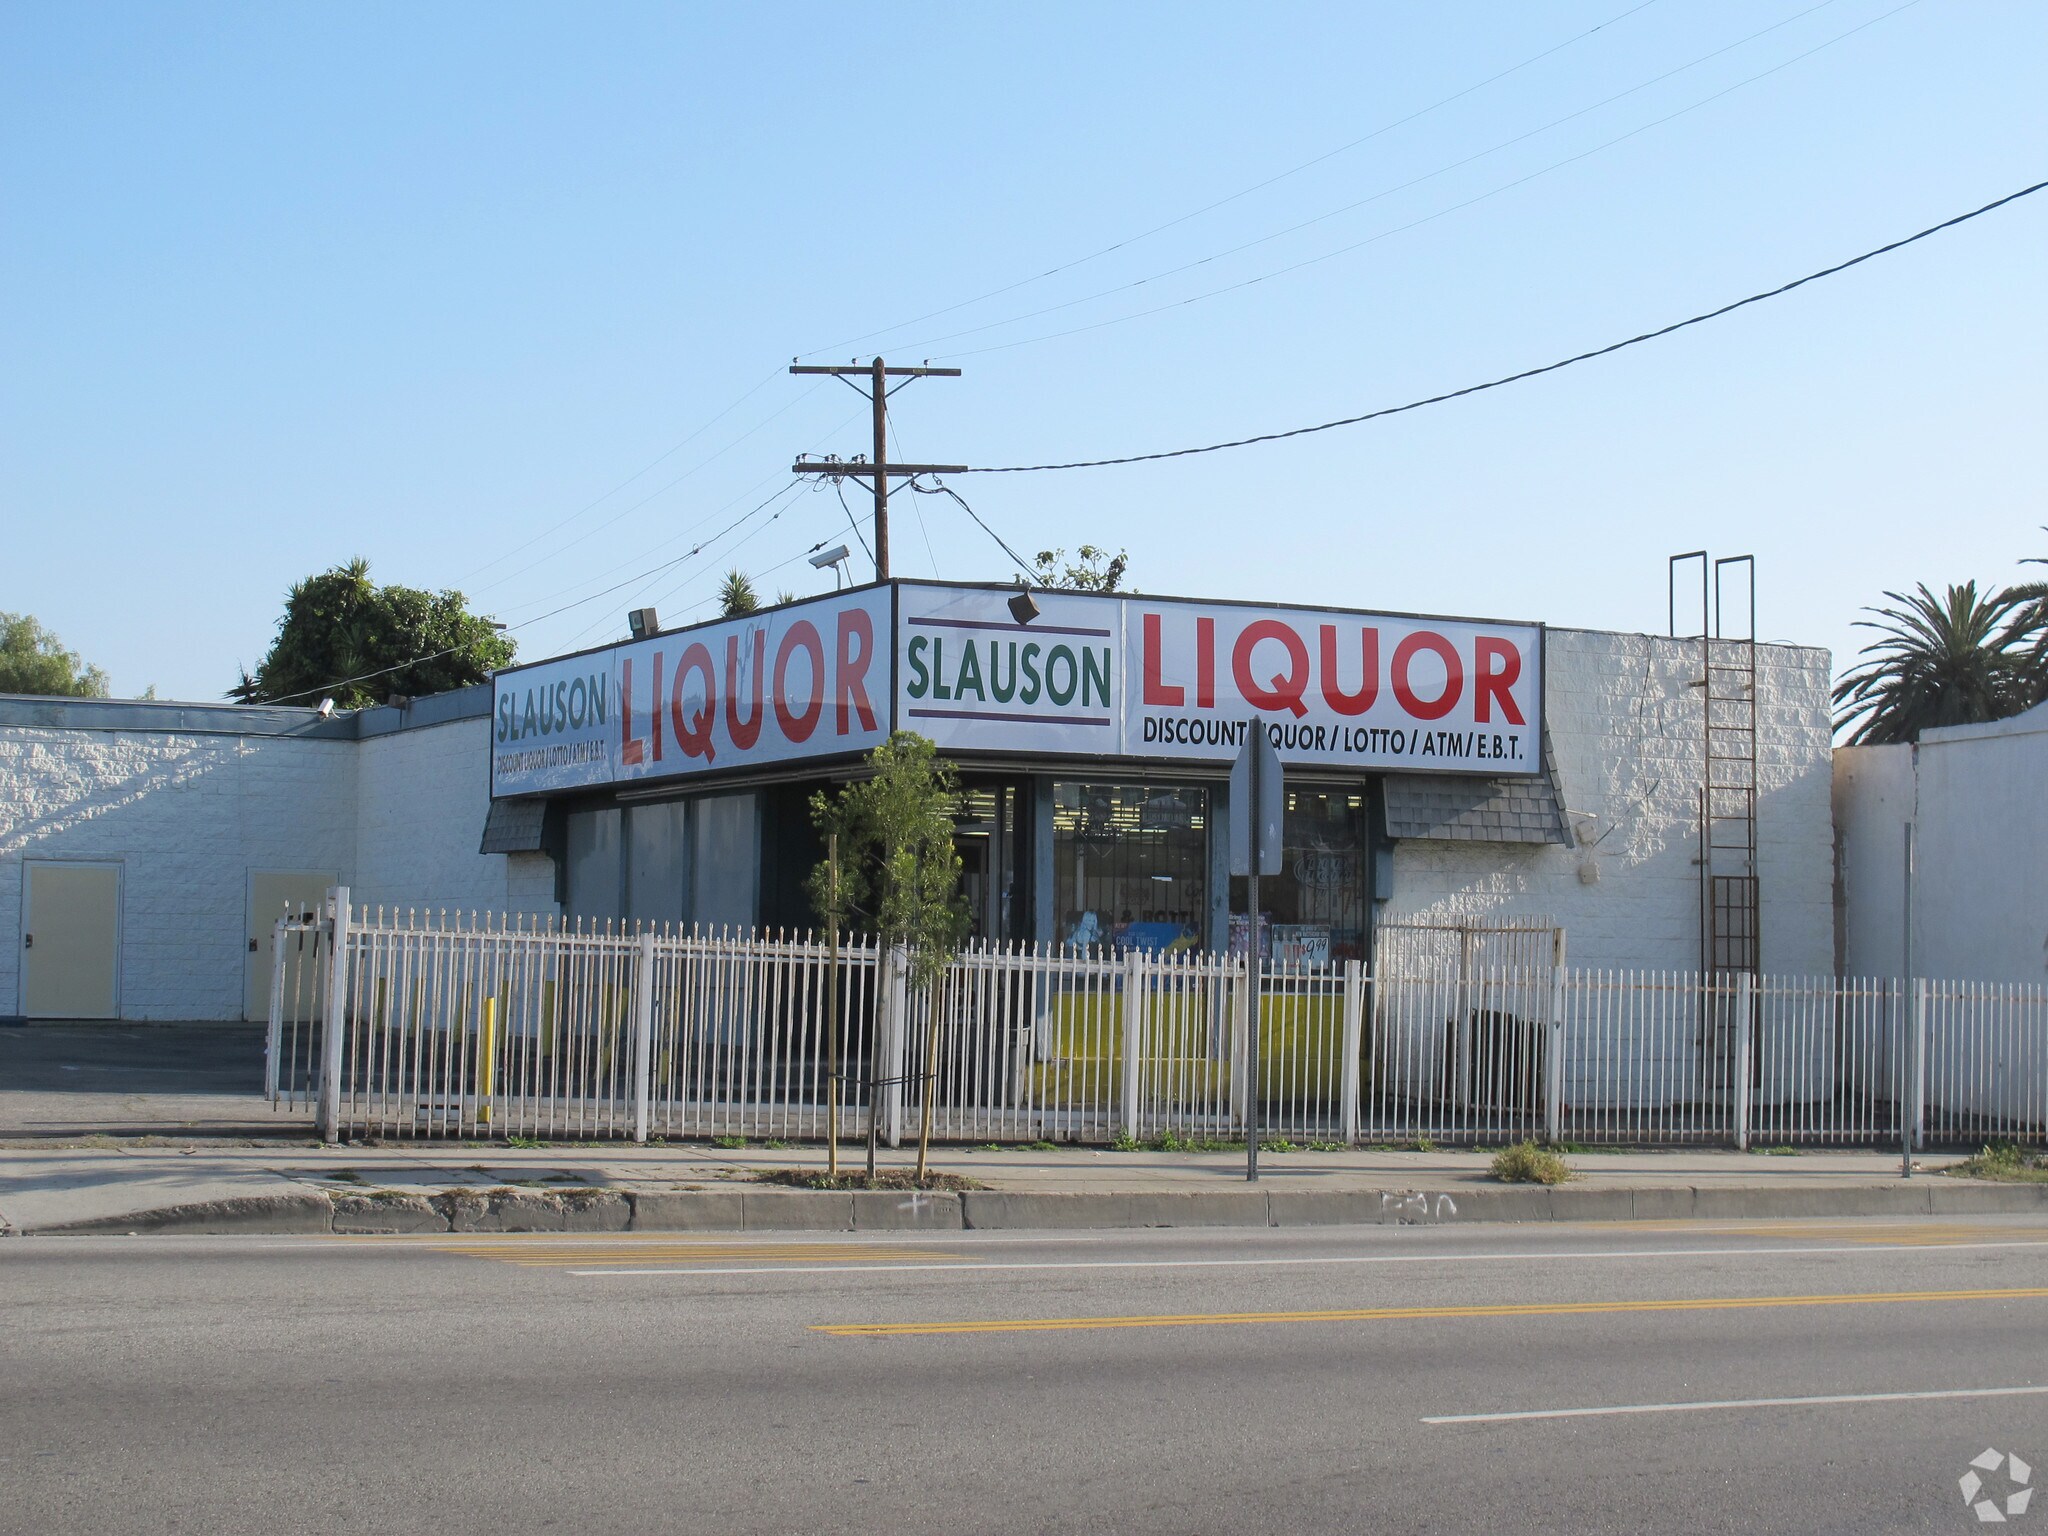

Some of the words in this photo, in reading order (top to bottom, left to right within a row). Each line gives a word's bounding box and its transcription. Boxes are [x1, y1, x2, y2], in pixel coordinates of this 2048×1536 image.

[621, 607, 878, 766] LIQUOR
[906, 633, 1112, 709] SLAUSON
[1143, 613, 1527, 726] LIQUOR
[497, 672, 607, 743] SLAUSON
[1143, 716, 1247, 746] DISCOUNT
[1262, 722, 1326, 751] QUOR
[1344, 727, 1405, 754] LOTTO
[1136, 936, 1158, 946] TWIST
